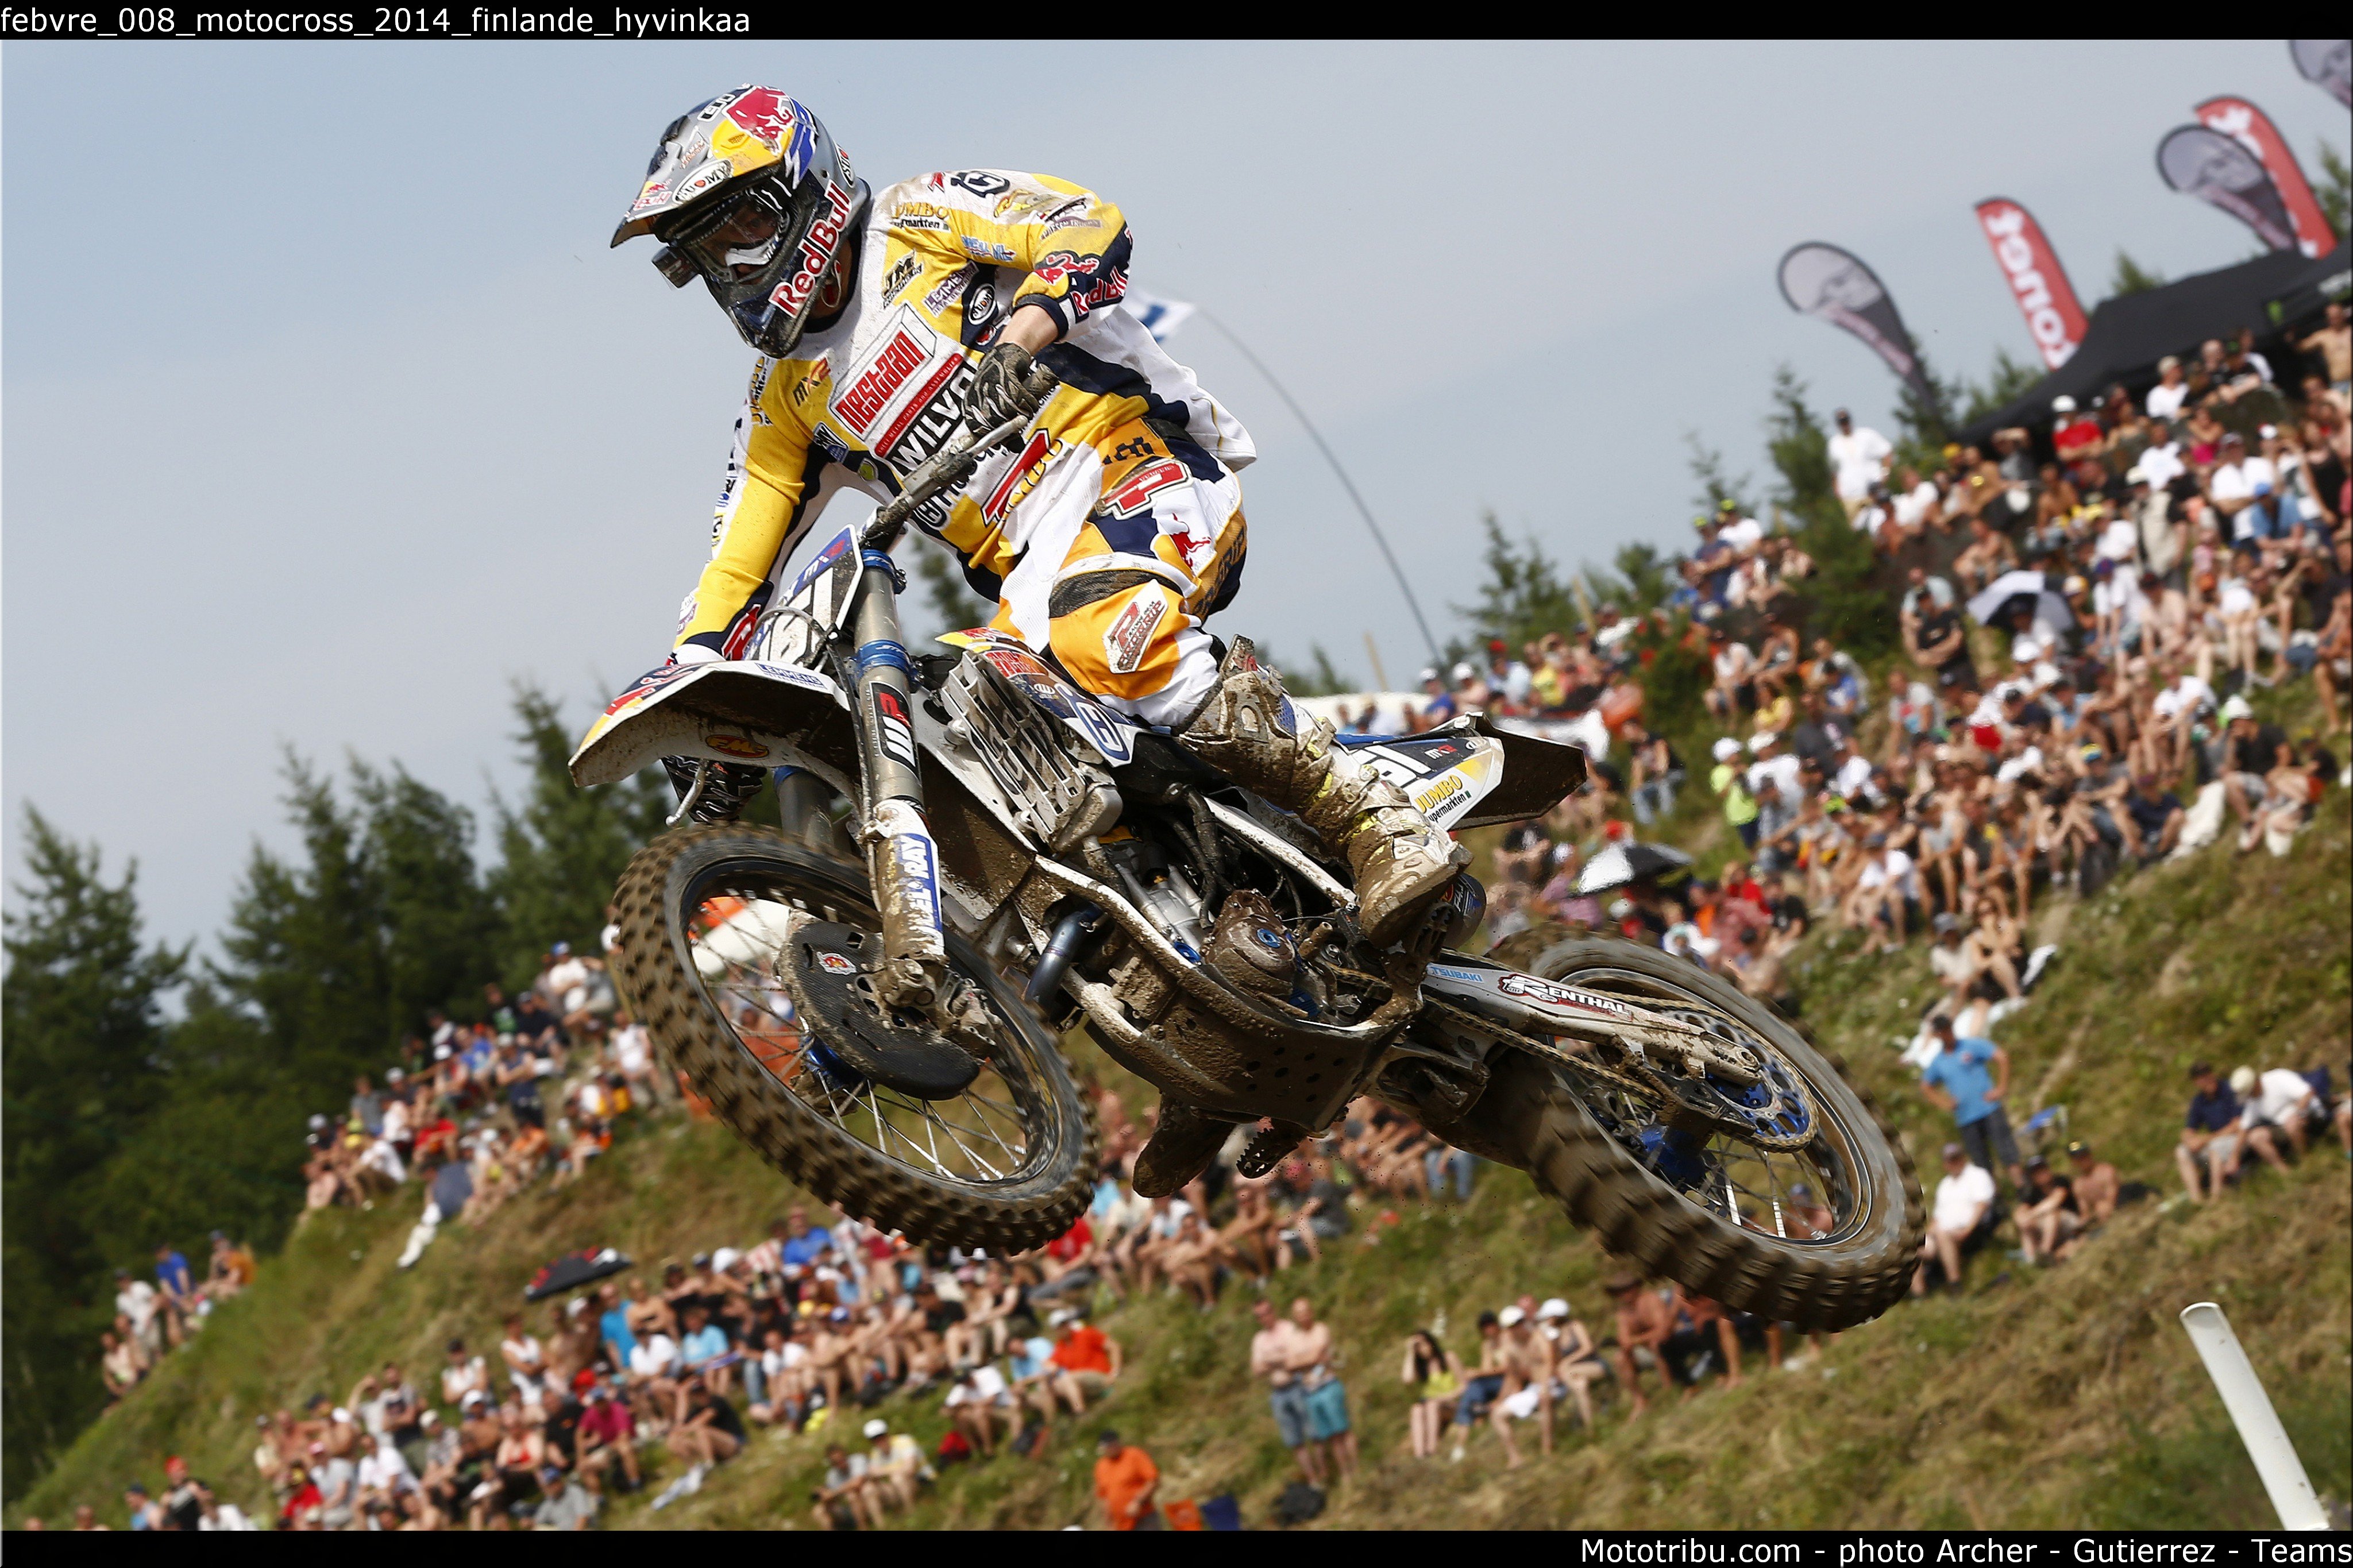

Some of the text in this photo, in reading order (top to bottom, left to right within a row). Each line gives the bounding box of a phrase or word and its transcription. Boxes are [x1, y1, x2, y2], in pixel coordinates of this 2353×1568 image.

[760, 665, 822, 685] LEMMENS
[1416, 774, 1463, 813] JUMBO
[1428, 795, 1465, 823] upermarkten
[1432, 967, 1483, 982] TSUBAKI
[1502, 976, 1630, 1014] RENTHAL
